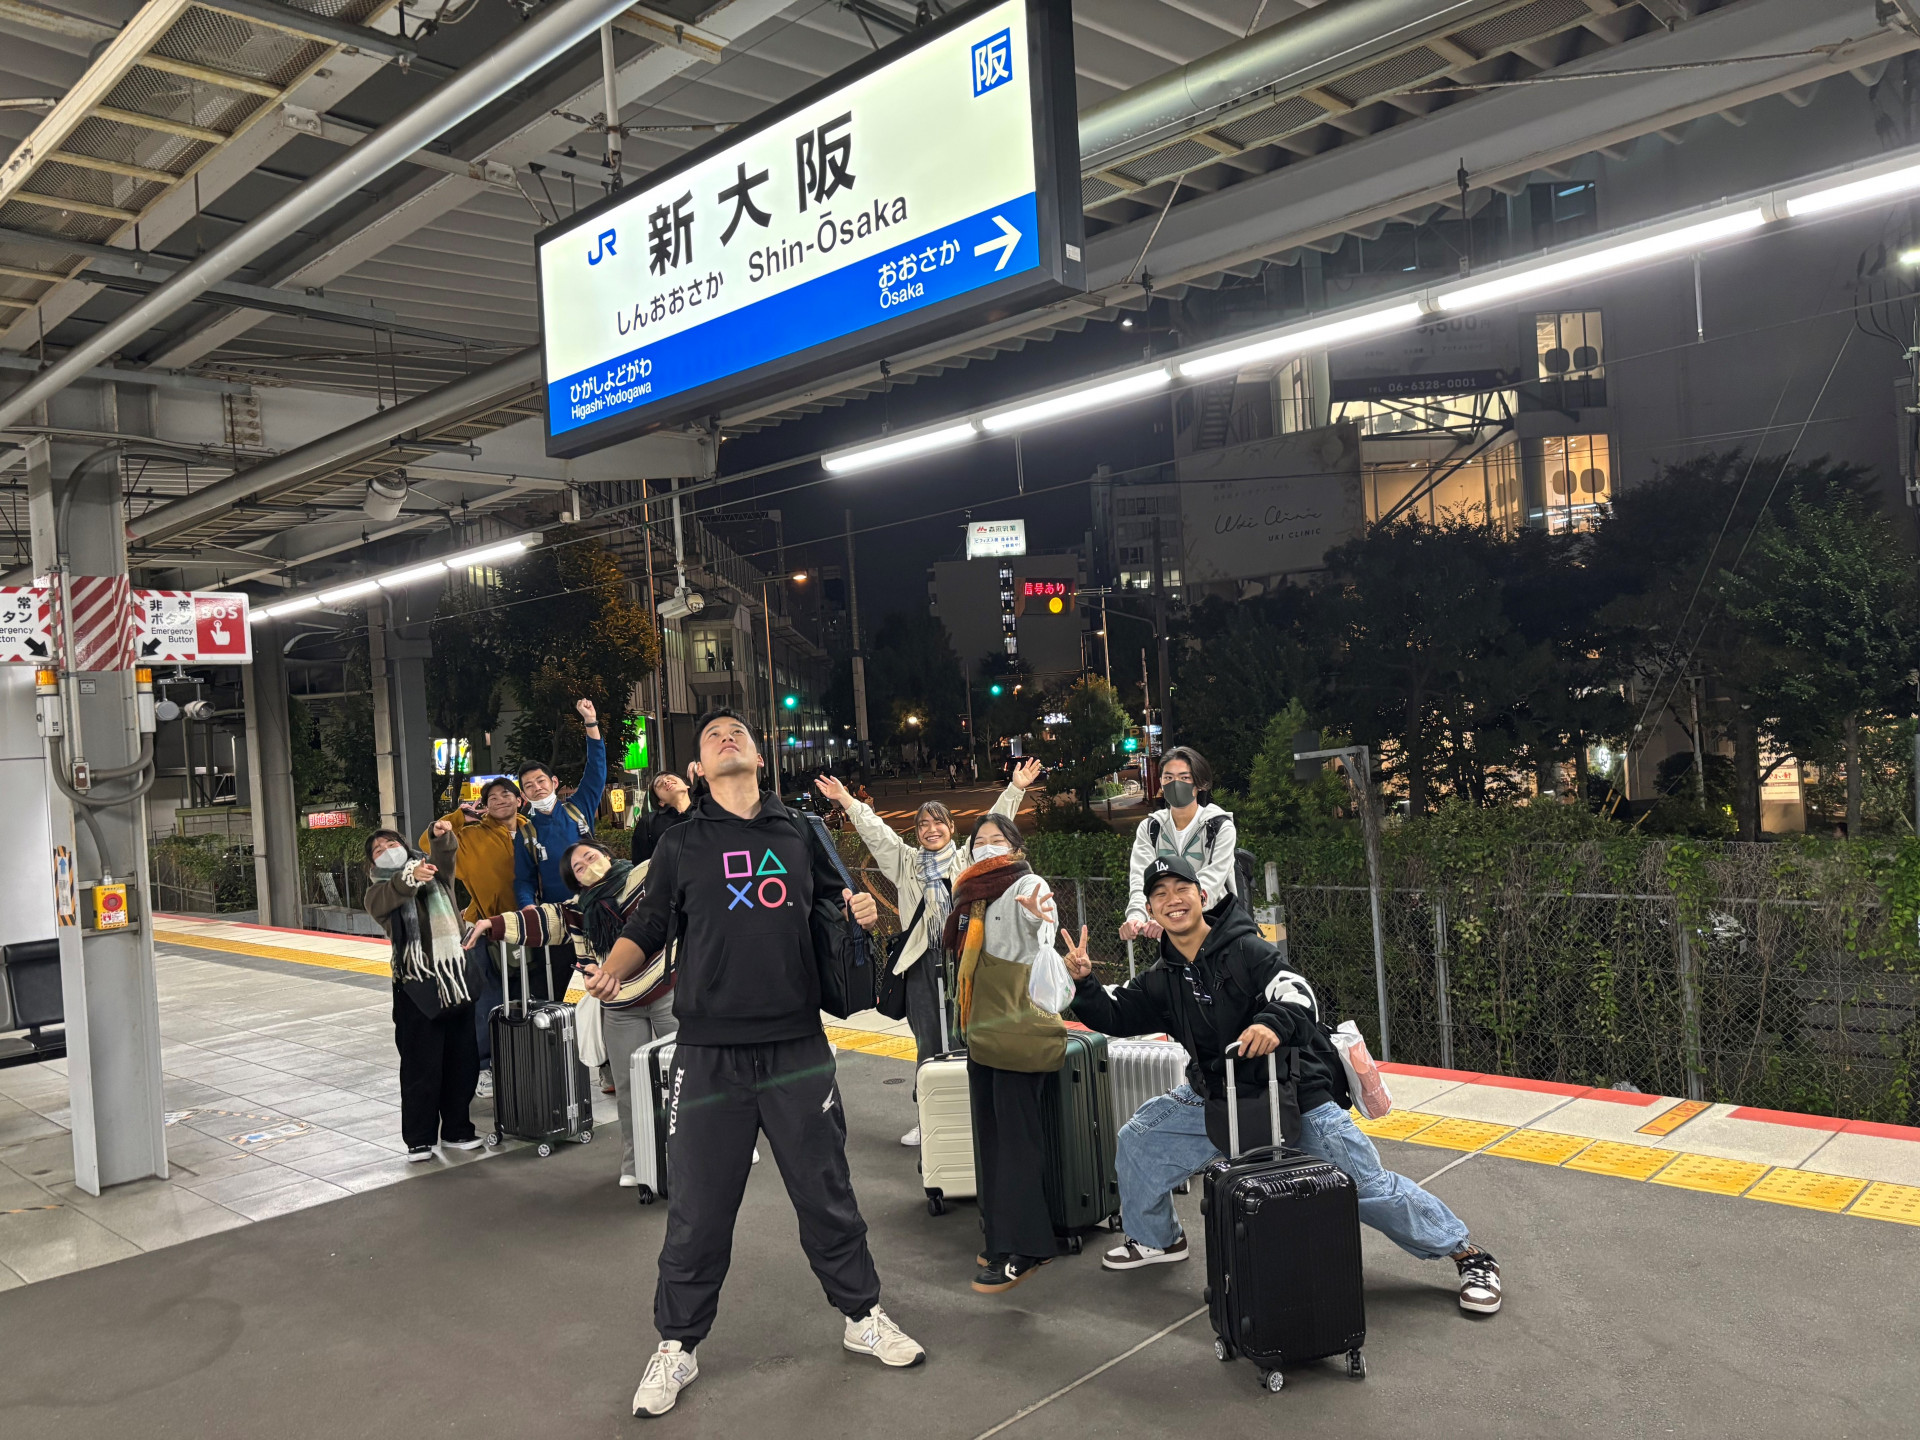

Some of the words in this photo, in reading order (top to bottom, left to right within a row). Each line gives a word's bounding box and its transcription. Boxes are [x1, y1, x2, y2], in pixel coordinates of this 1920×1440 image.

[975, 37, 1009, 91] 阪
[648, 111, 856, 277] 新大阪
[588, 228, 617, 266] JR
[748, 195, 908, 283] Shin-Ōsaka
[877, 239, 961, 290] おおさか
[616, 270, 724, 336] しんおおさか
[879, 281, 924, 309] Ōsaka
[569, 357, 652, 403] ひがしよどがわ
[1388, 377, 1477, 393] 06-6328-0001
[570, 380, 652, 420] Higashi-Yodogawa
[1288, 527, 1321, 539] CLINIC
[17, 596, 31, 609] 常
[1024, 582, 1065, 595] 信号あり
[149, 599, 191, 612] 非常
[200, 605, 238, 619] SOS
[151, 627, 193, 636] Emergency
[1154, 859, 1169, 873] LA
[669, 1066, 685, 1136] HONDA
